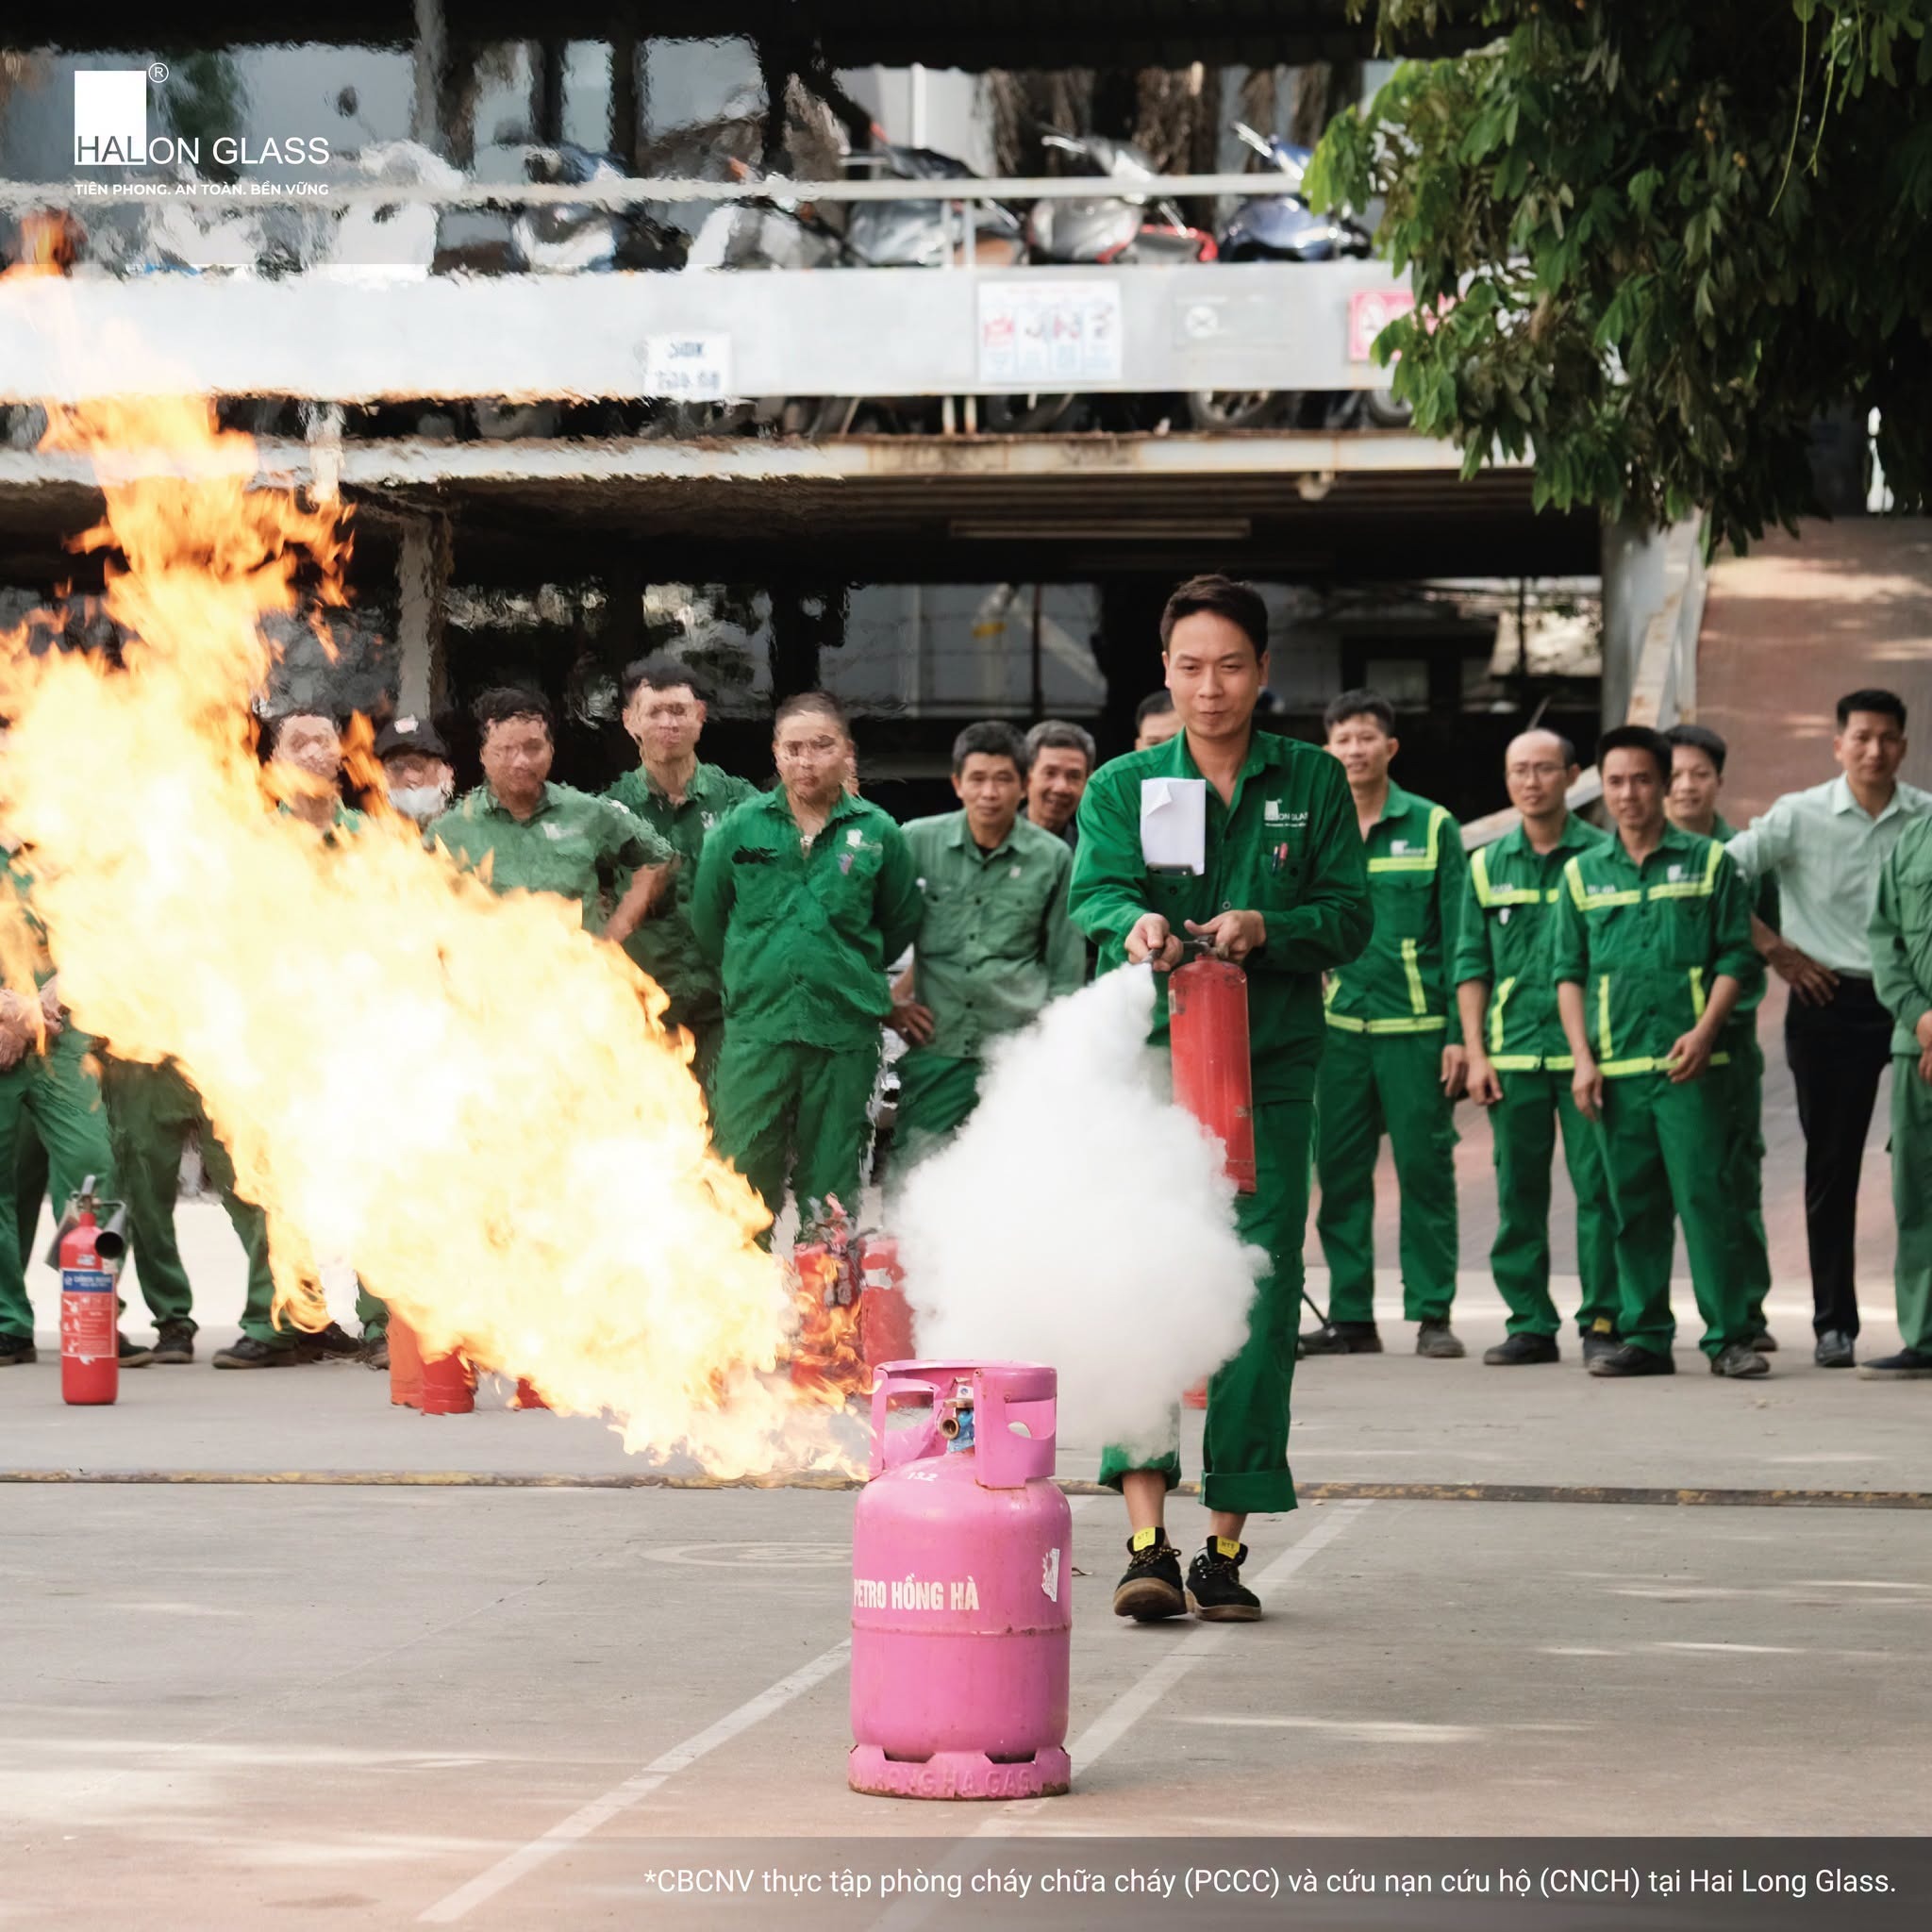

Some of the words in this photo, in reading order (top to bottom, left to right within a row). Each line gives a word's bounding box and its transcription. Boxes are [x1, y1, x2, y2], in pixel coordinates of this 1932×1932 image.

[853, 1578, 887, 1609] PETRO
[891, 1573, 944, 1611] HỒNG
[950, 1575, 980, 1611] HÀ
